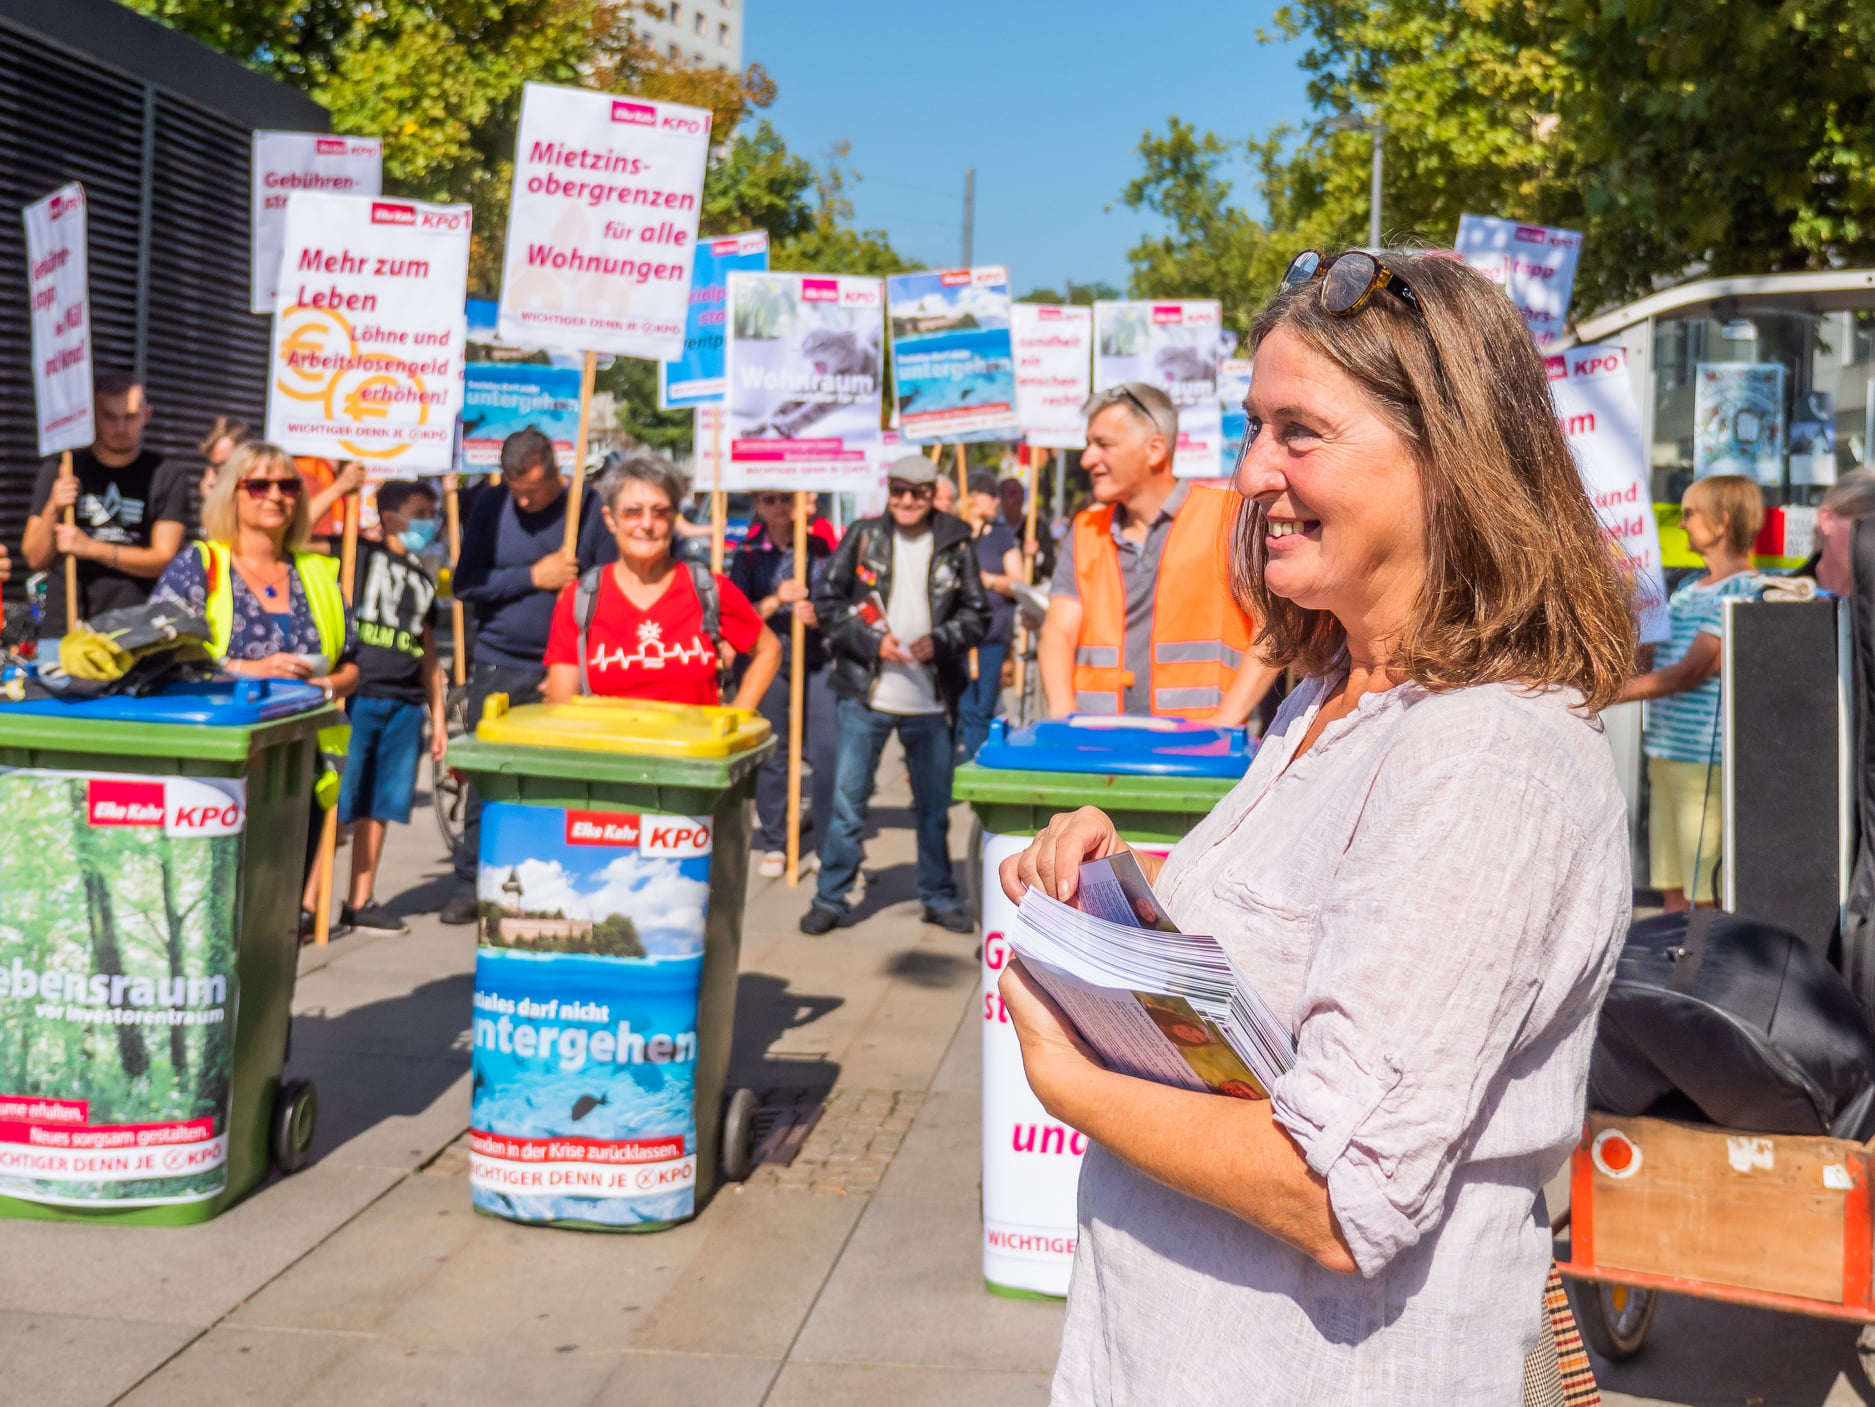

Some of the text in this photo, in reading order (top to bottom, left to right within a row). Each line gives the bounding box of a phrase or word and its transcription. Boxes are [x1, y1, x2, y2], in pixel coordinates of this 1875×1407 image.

[661, 116, 701, 134] KPÖ
[529, 141, 652, 175] Mietzins-
[264, 171, 360, 190] Gebühren-
[527, 172, 696, 211] obergrenzen
[604, 220, 688, 247] für alle
[297, 248, 430, 278] Mehr zum
[527, 243, 685, 284] Wohnungen
[296, 284, 378, 313] Leben
[350, 325, 451, 347] Löhne und
[286, 350, 449, 379] Arbeitslosengeld
[1573, 354, 1619, 376] KPÖ
[740, 366, 875, 394] Wohnraum
[361, 382, 448, 406] erhöhen!
[1596, 482, 1638, 508] und
[94, 801, 240, 828] Elke Kahr KPÖ
[571, 821, 710, 849] Elke Kahr KPÖ
[65, 1004, 225, 1026] Investorentraum
[516, 997, 559, 1020] darf
[559, 1001, 611, 1024] nicht
[30, 1126, 71, 1145] Neues
[71, 1131, 135, 1149] sorgsam
[73, 1157, 129, 1173] DENN
[136, 1155, 154, 1170] JE
[187, 1143, 222, 1165] KPÖ
[507, 1141, 520, 1158] in
[520, 1142, 548, 1160] der
[549, 1143, 586, 1159] Krise
[585, 1143, 681, 1162] zurücklassen.
[549, 1171, 601, 1187] DENN
[607, 1173, 628, 1189] JE
[658, 1163, 693, 1186] KPÖ
